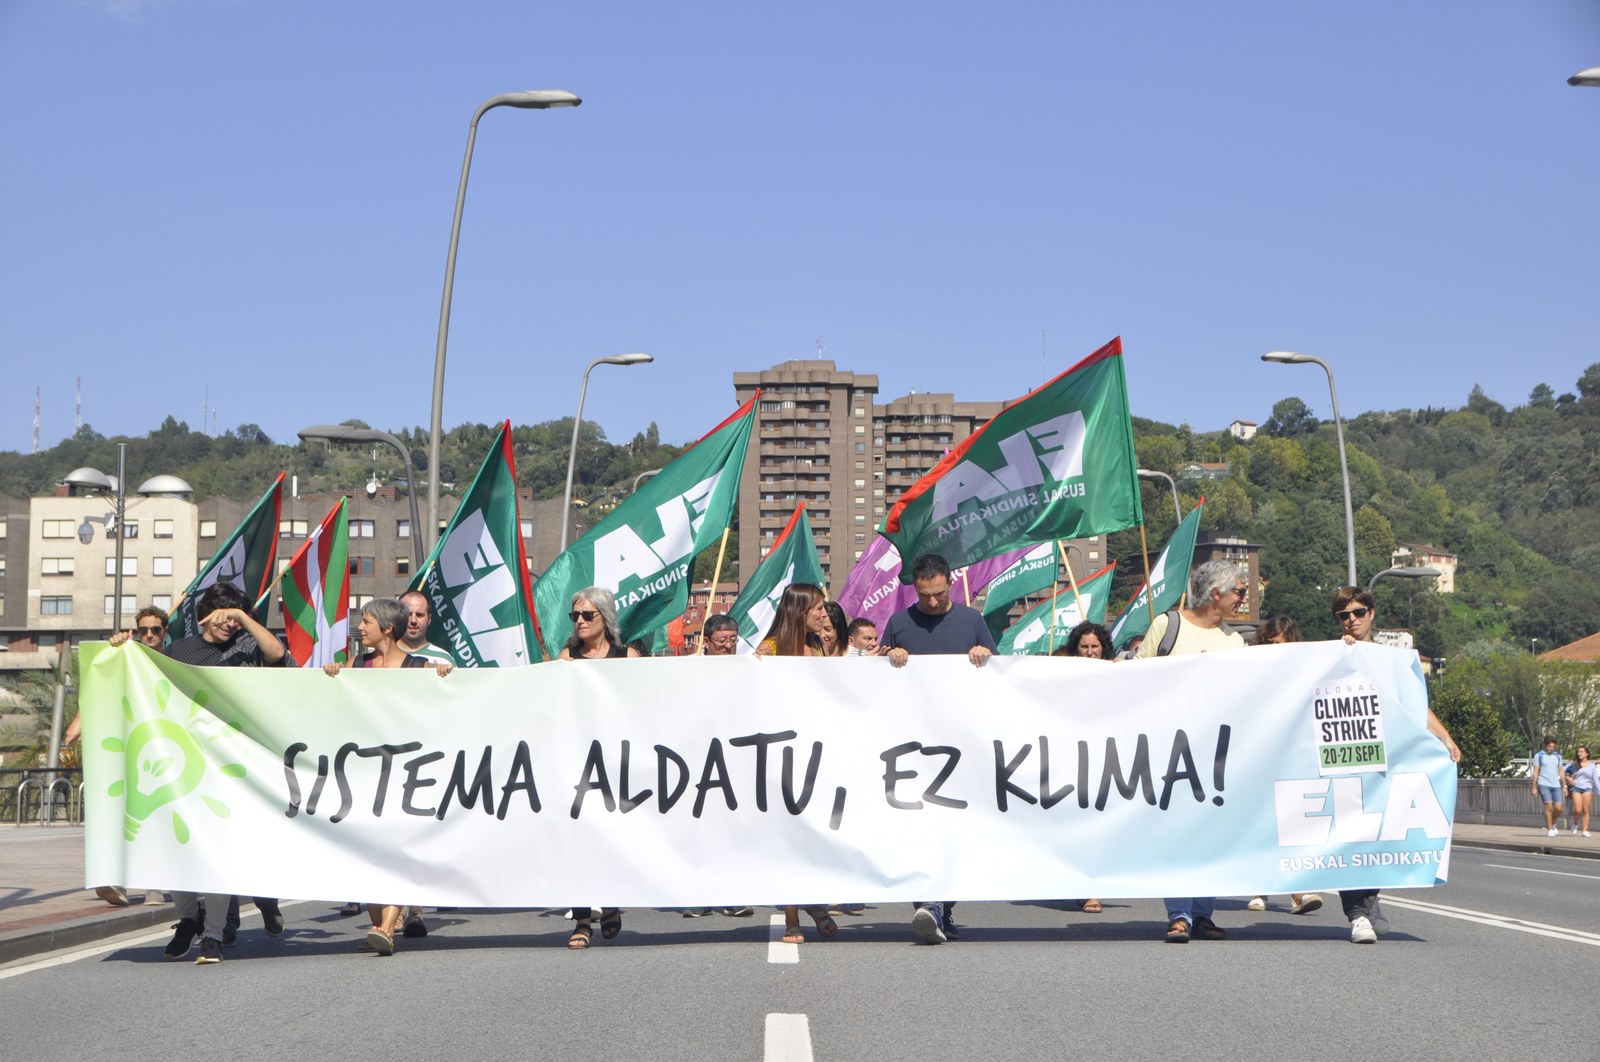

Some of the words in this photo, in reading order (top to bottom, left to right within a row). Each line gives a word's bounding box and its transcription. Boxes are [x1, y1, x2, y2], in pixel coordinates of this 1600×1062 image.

[443, 618, 480, 667] SINDI
[1315, 684, 1376, 696] GLOBAL
[1314, 694, 1380, 720] CLIMATE
[1321, 718, 1378, 743] STRIKE
[1323, 746, 1353, 765] 20-27
[1355, 744, 1380, 762] SEPT
[283, 740, 541, 823] SISTEMA
[570, 729, 847, 831] ALDATU,
[879, 741, 969, 810] EZ
[993, 724, 1231, 812] KLIMA!
[1274, 772, 1450, 847] ELA
[1279, 853, 1349, 872] EUSKAL
